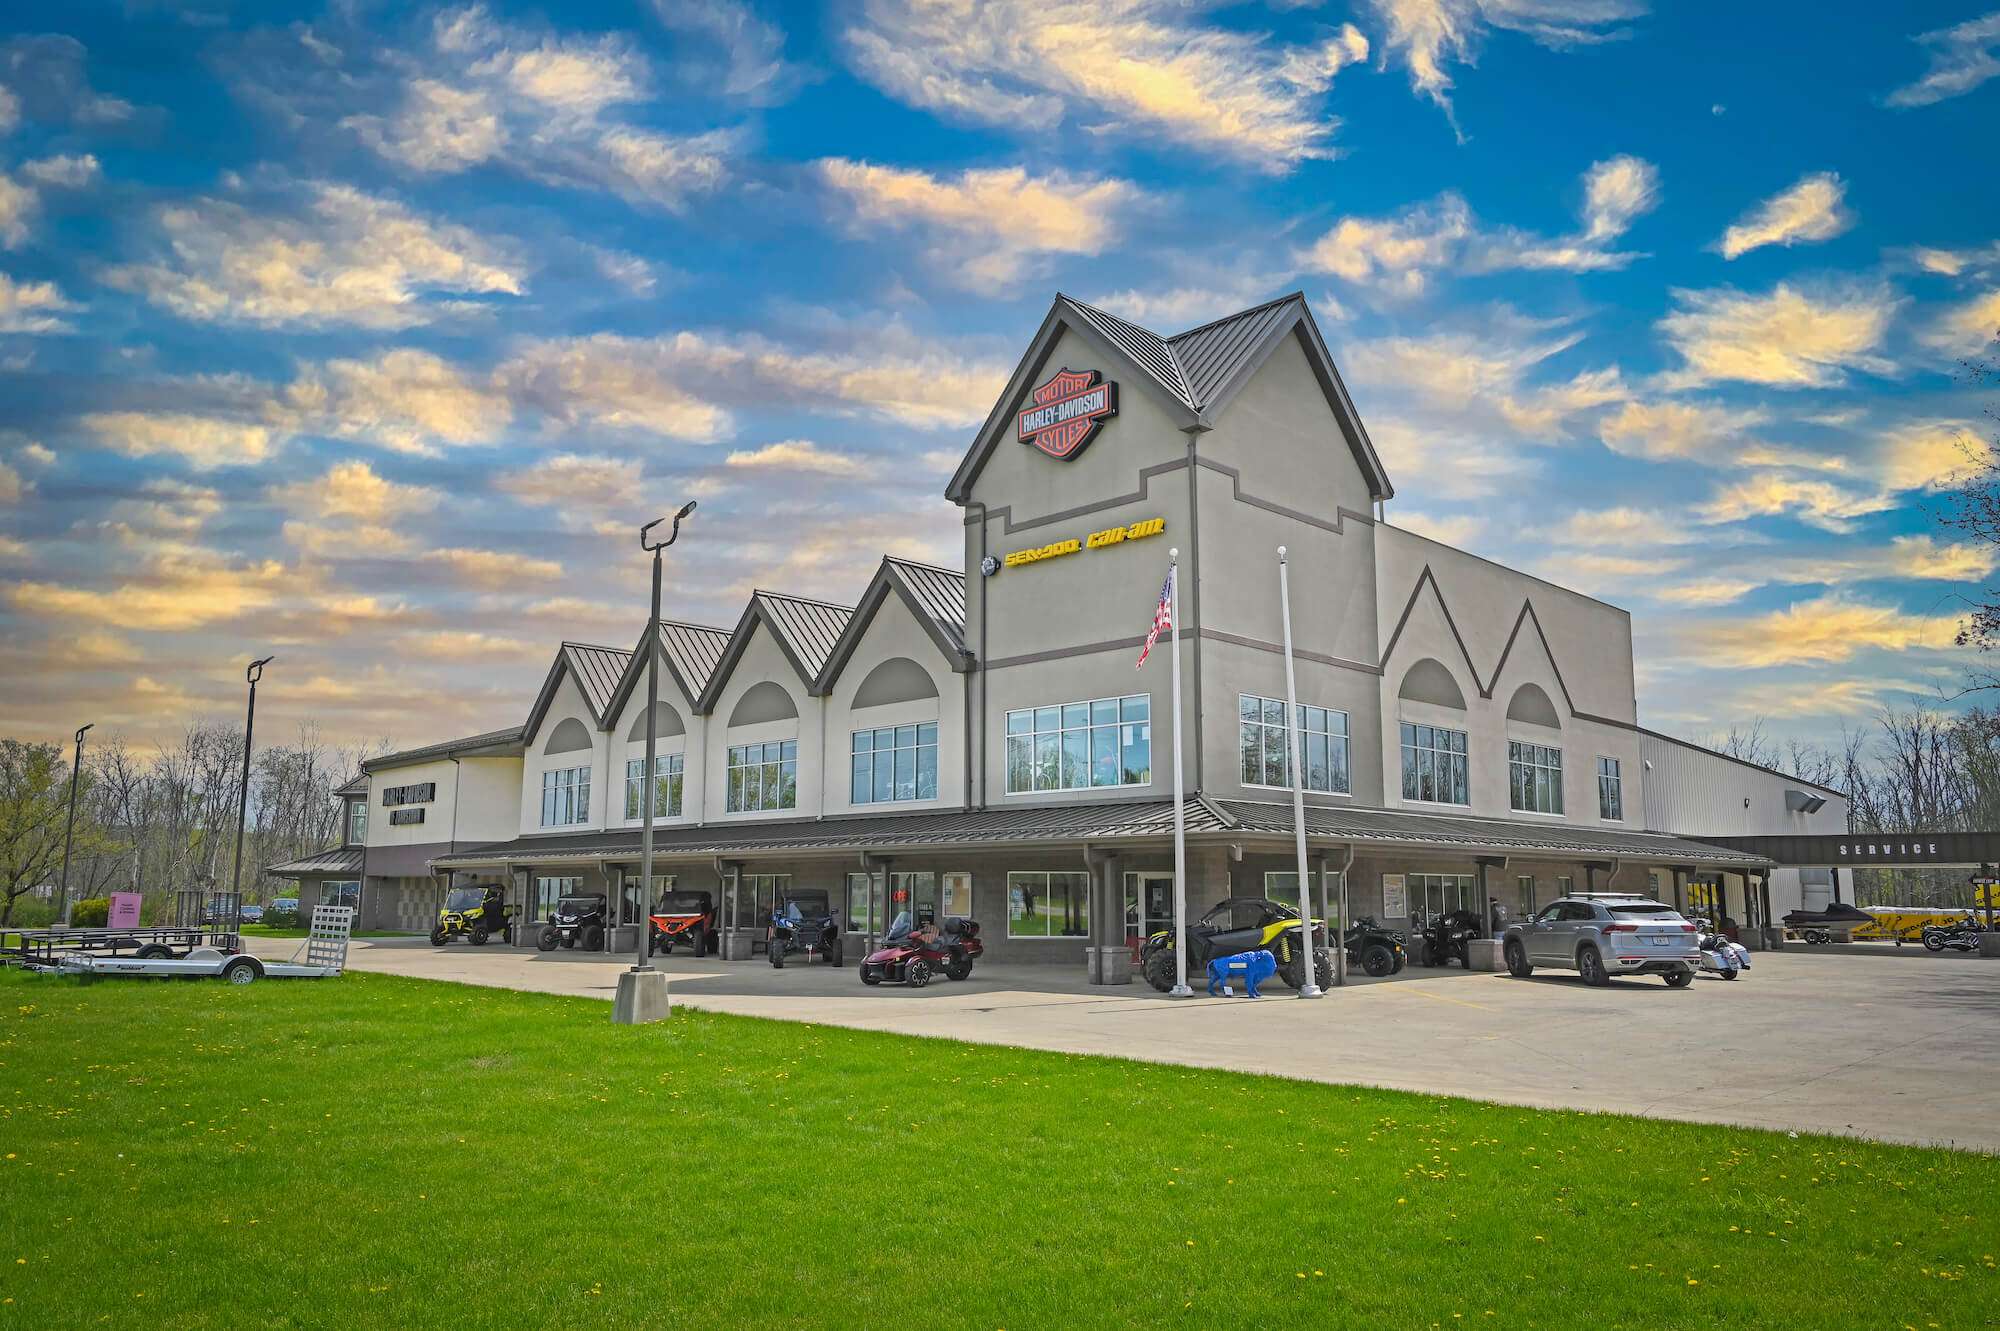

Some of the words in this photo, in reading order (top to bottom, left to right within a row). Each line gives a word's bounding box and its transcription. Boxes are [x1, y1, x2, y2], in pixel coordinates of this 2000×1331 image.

[1041, 378, 1086, 402] MOTOR
[1023, 390, 1105, 433] HARLEY-DAVIDSON
[1041, 422, 1083, 450] CYCLES
[1839, 843, 1937, 855] SERVICE
